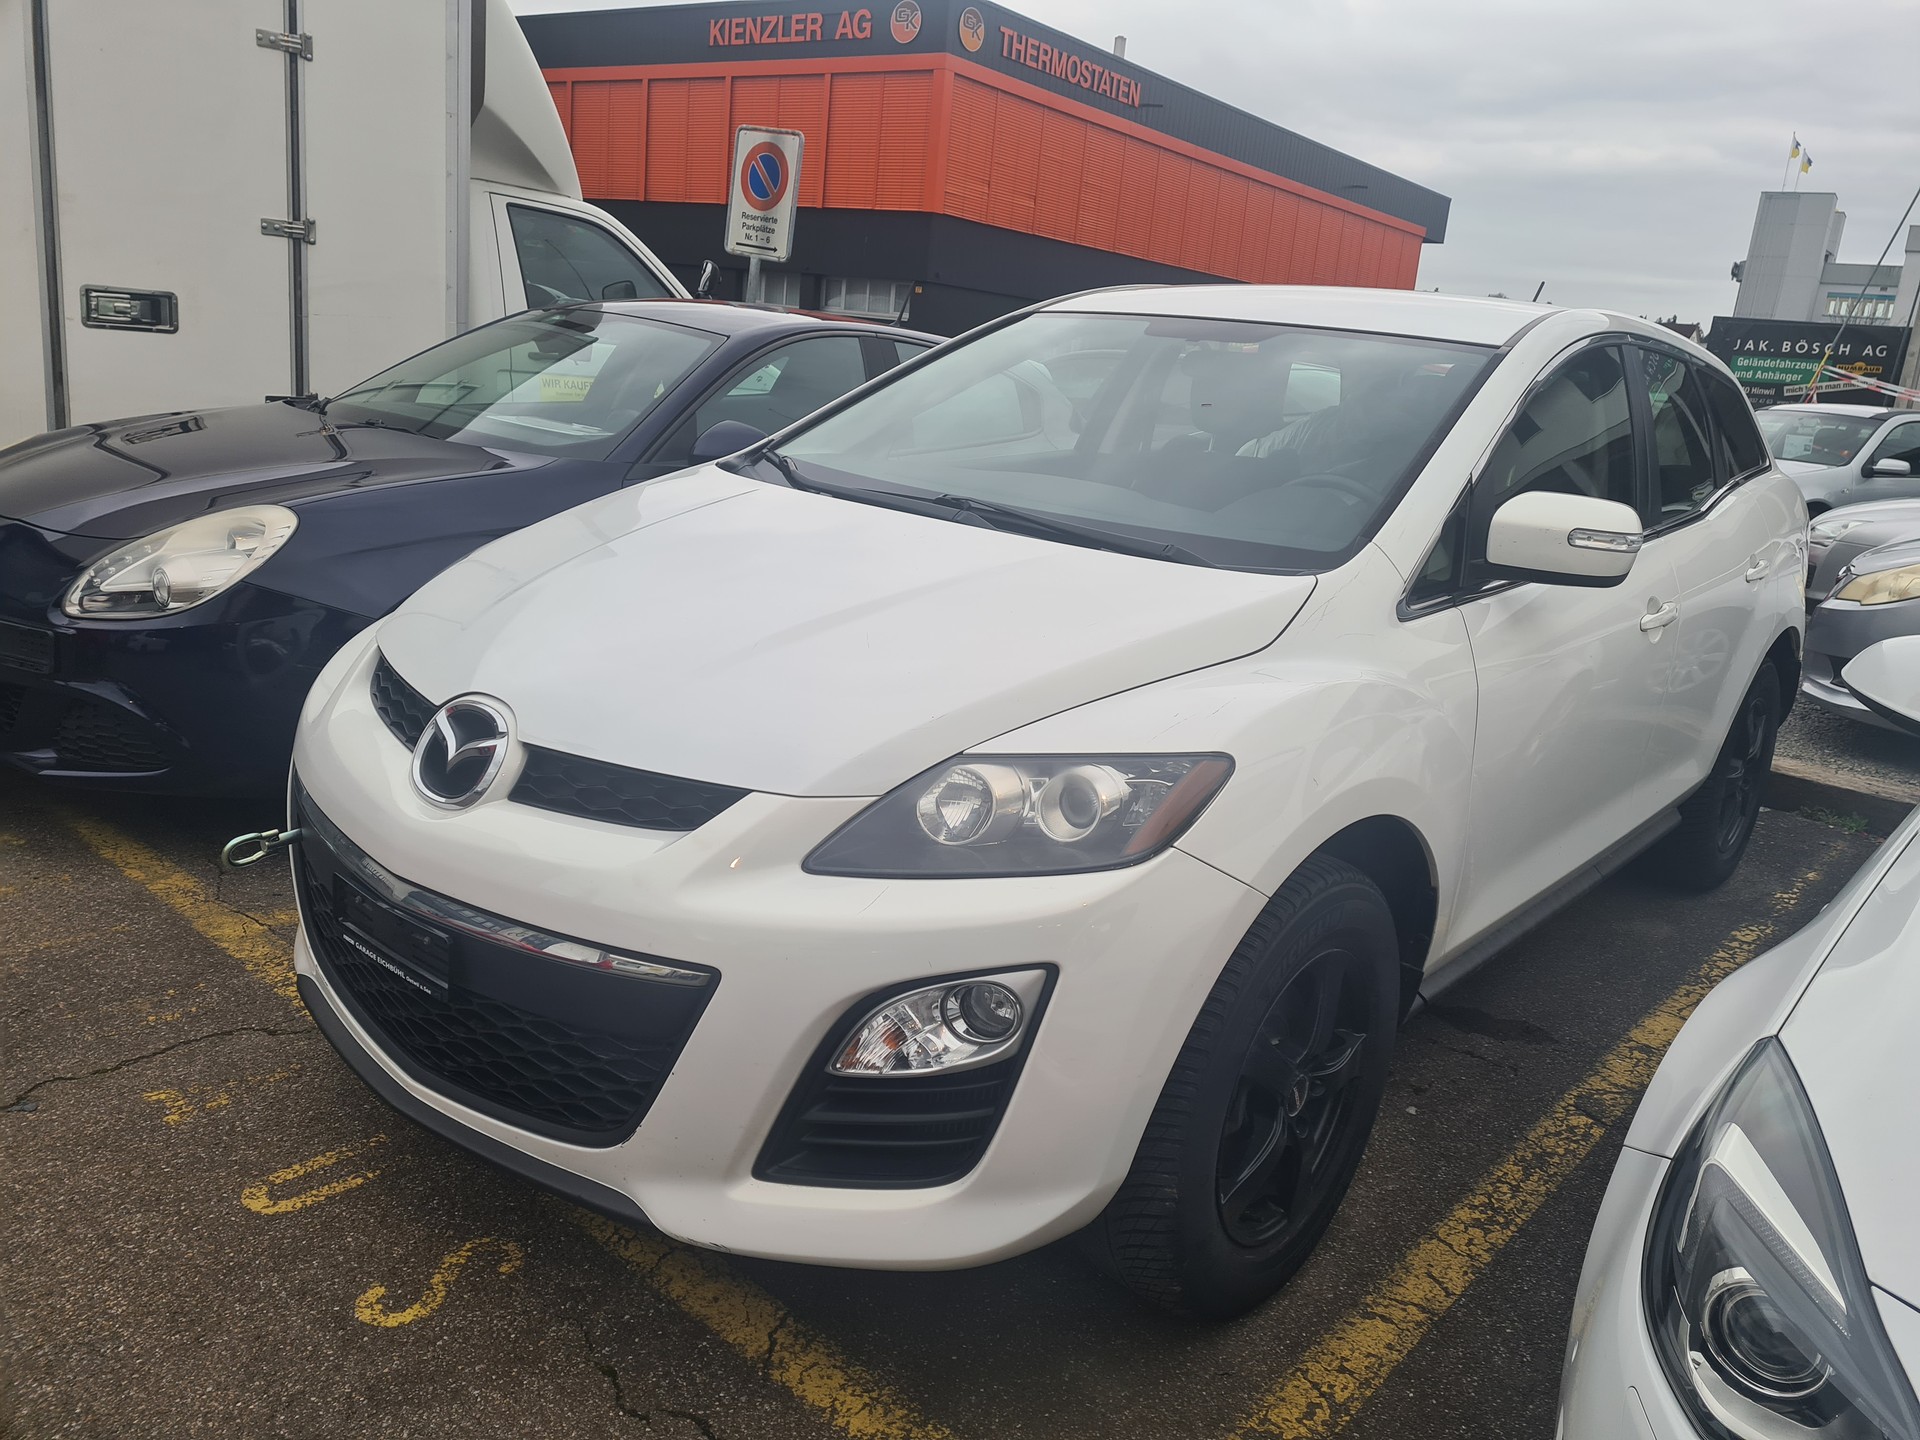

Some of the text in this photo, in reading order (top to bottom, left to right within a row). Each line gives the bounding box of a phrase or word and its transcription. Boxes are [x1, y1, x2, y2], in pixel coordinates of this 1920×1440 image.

[709, 9, 873, 46] KIENZLER AG
[1000, 27, 1142, 108] THERMOSTATEN
[742, 212, 778, 224] Reservierte
[742, 222, 775, 234] Parkplätze
[745, 233, 753, 241] Nr.
[766, 236, 771, 244] 6
[1733, 339, 1888, 357] JAK. BÖSCH AG
[1734, 370, 1803, 383] und Anhänger
[541, 378, 561, 388] WIR
[1785, 386, 1803, 394] mich
[1825, 382, 1841, 391] man
[1751, 386, 1776, 395] Hinwil
[355, 942, 376, 960] GARAGE
[377, 956, 405, 979] EICHBÜHL
